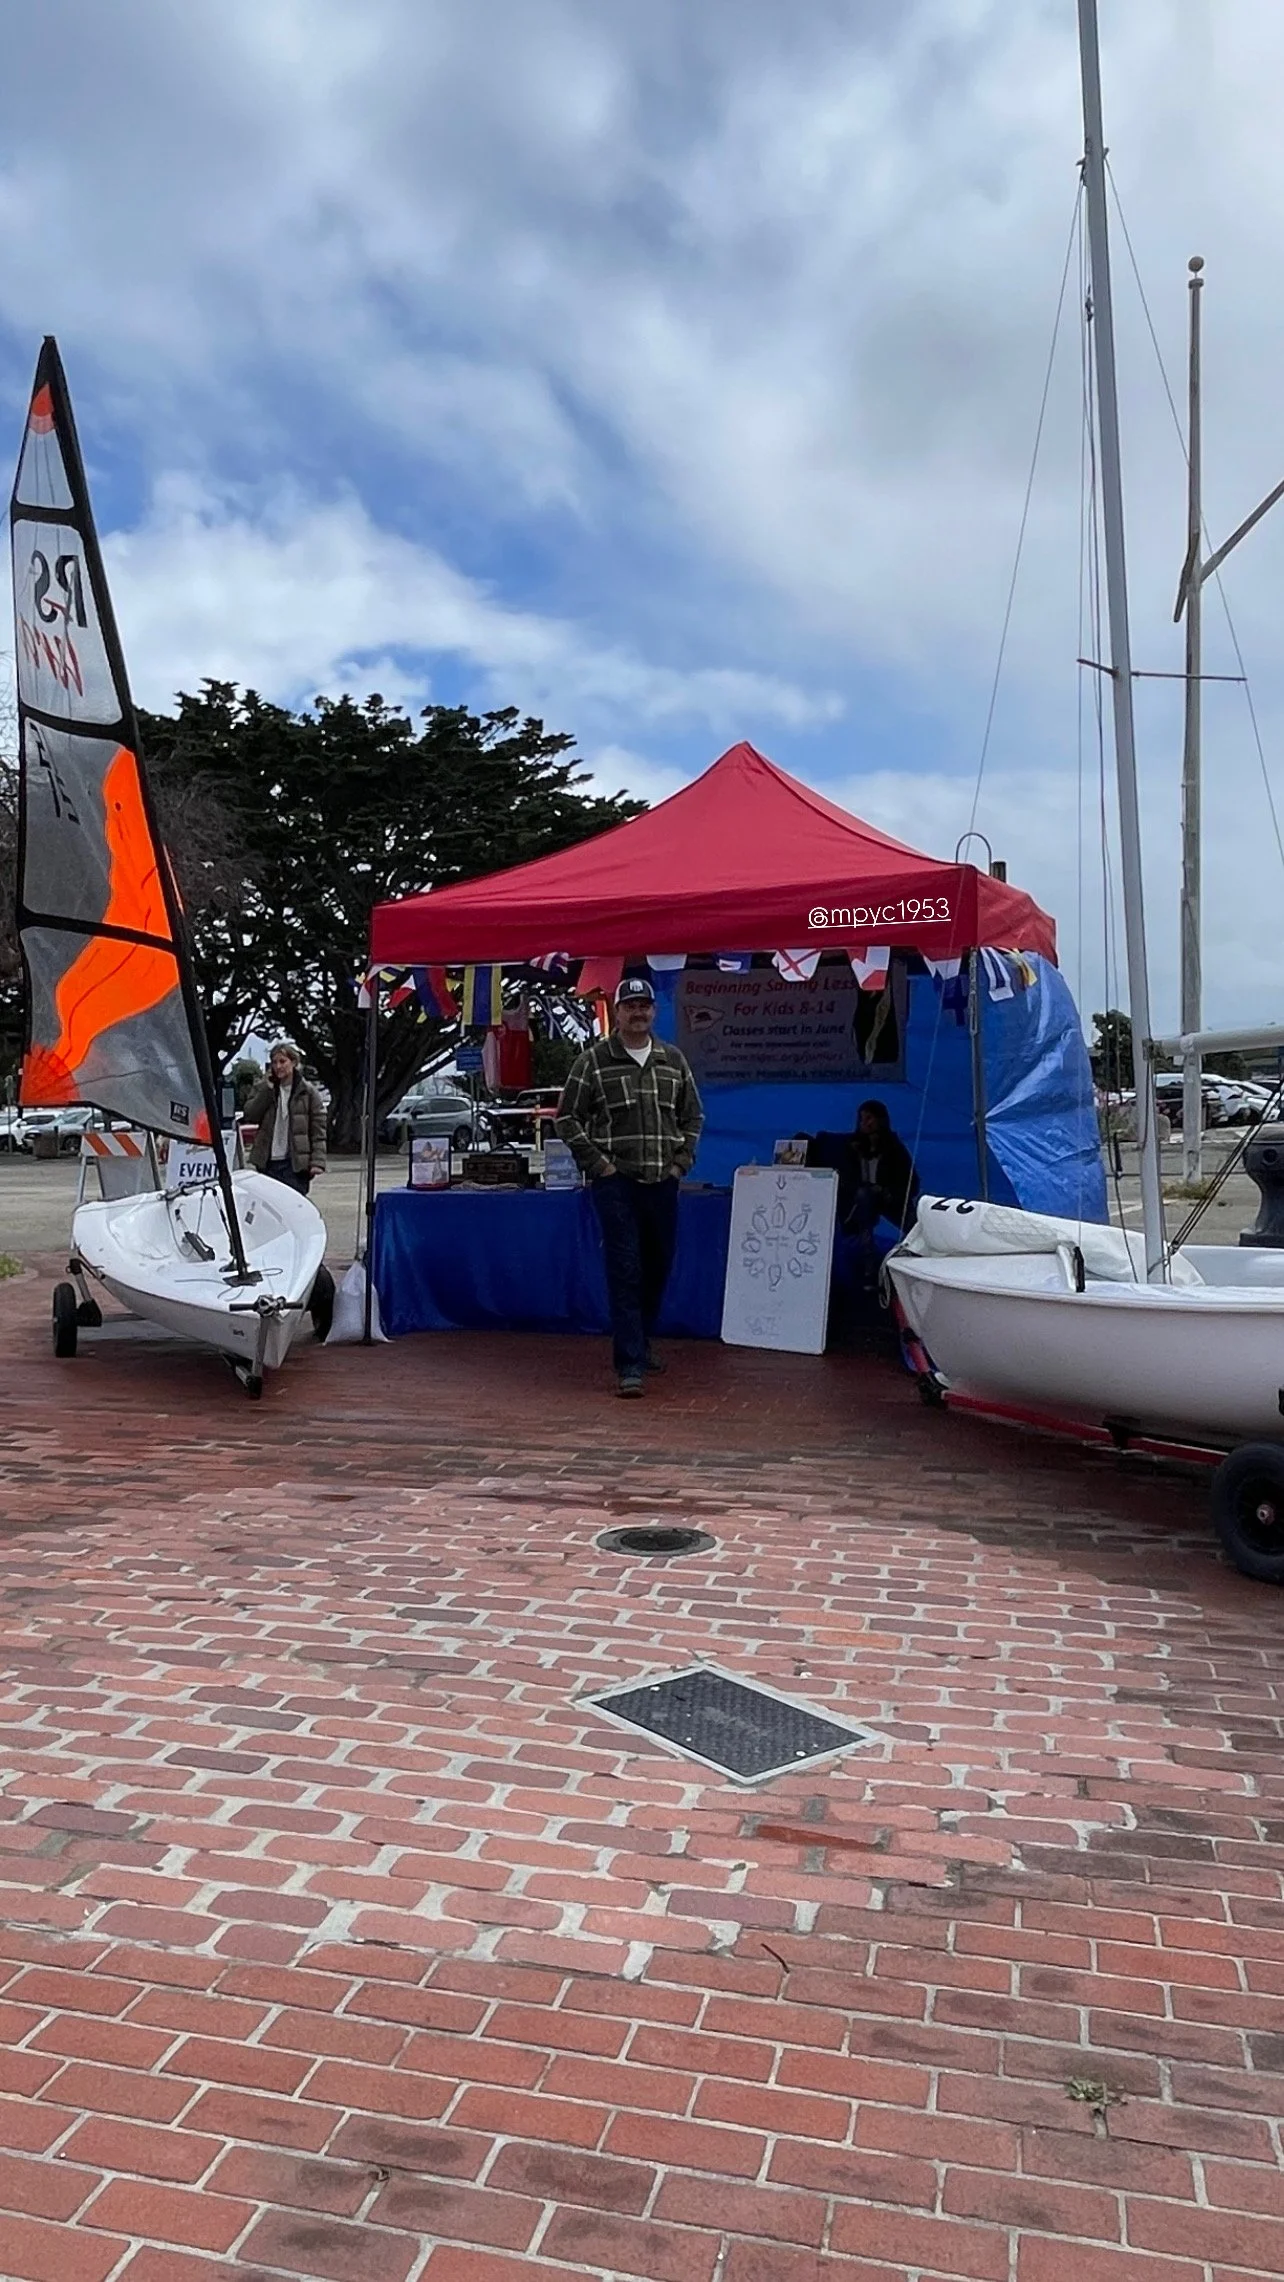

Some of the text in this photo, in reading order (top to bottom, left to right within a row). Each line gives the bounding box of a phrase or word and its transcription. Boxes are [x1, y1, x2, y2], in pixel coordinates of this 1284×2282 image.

[686, 980, 762, 997] Beginning
[823, 977, 857, 991] Less
[733, 1001, 835, 1016] For Kids 8-14
[722, 1023, 845, 1037] Classes start in June
